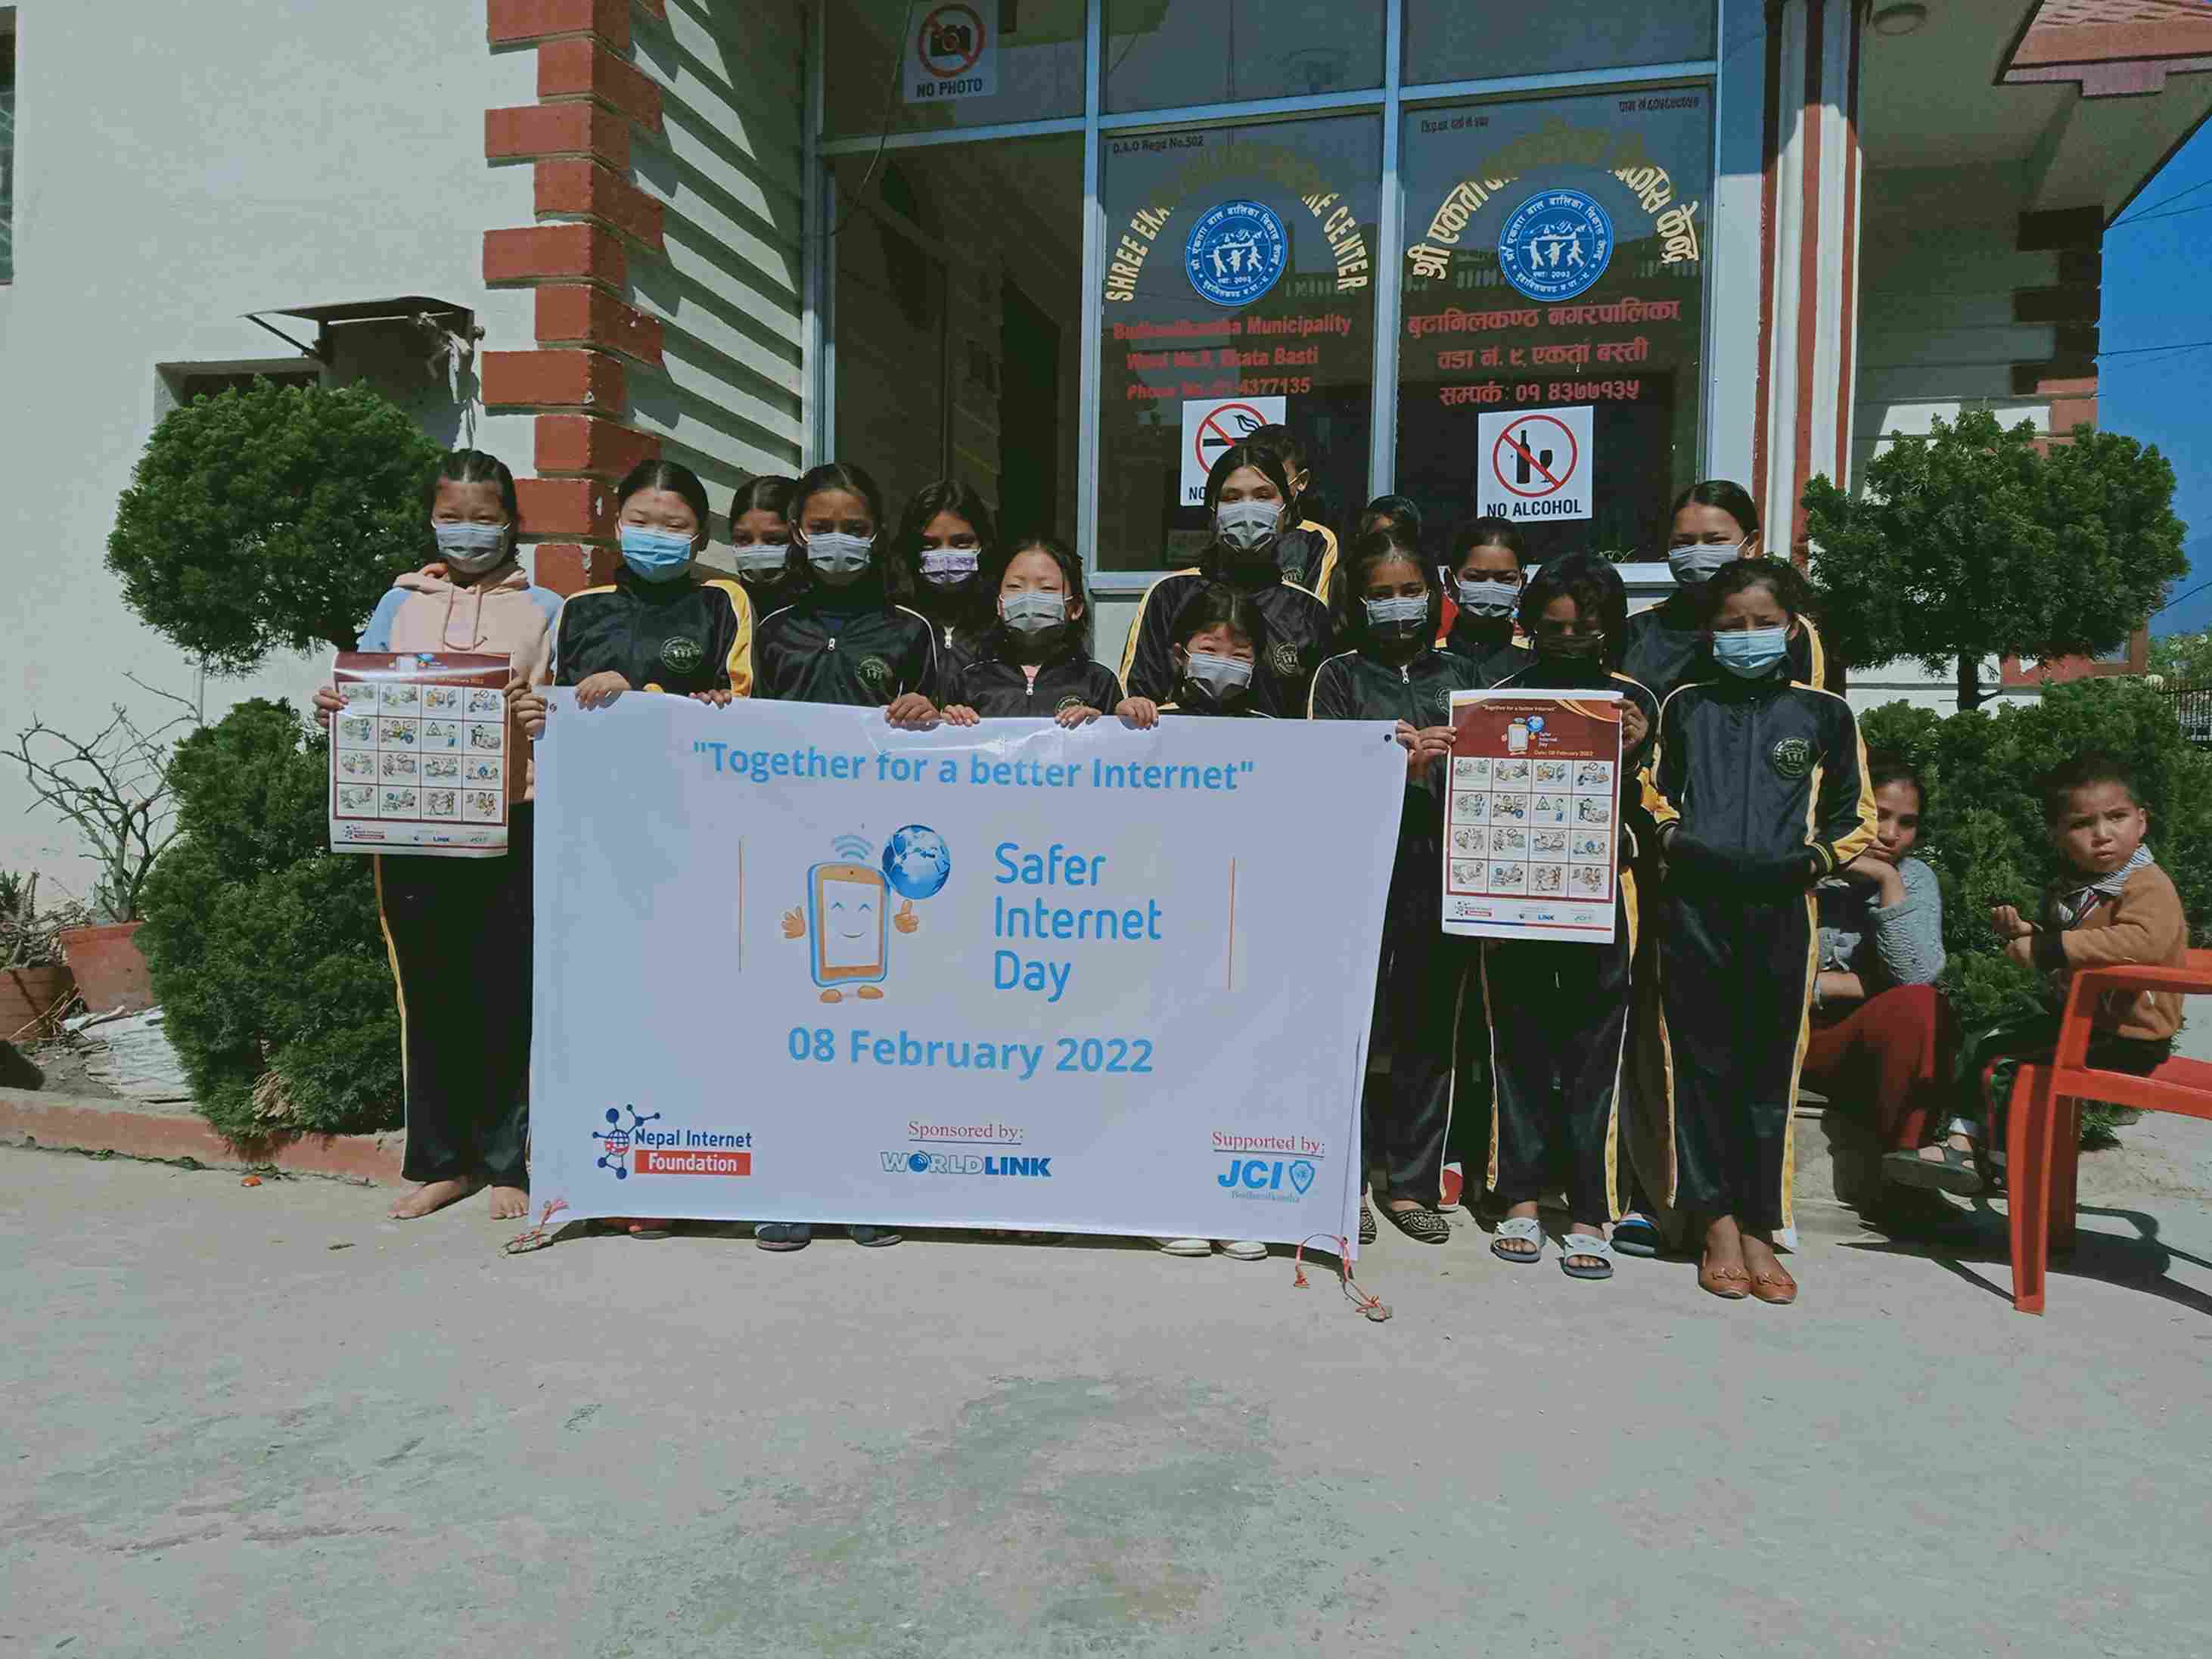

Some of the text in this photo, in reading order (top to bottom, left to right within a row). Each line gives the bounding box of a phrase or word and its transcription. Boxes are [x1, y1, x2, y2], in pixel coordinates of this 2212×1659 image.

[917, 78, 983, 97] NO PHOTO
[1427, 182, 1490, 244] एकता
[1324, 206, 1368, 291] CENTER
[1407, 242, 1451, 280] श्री
[1105, 235, 1149, 302] SHREE
[1247, 314, 1352, 337] Municipality
[1274, 344, 1319, 365] Basti
[1188, 486, 1205, 501] NO
[1487, 499, 1583, 518] NO ALCOHOL
[693, 741, 1254, 791] "Together for a better Internet"
[994, 842, 1106, 886] Safer
[994, 896, 1162, 941] Internet
[994, 950, 1072, 1003] Day
[788, 1027, 1154, 1081] 08 February 2022
[635, 1129, 752, 1150] Nepal Internet
[909, 1120, 993, 1139] Sponsored
[1212, 1131, 1296, 1151] Supported
[648, 1152, 738, 1172] Foundation
[880, 1150, 1052, 1178] WORLDLINK
[1217, 1159, 1284, 1190] JCI
